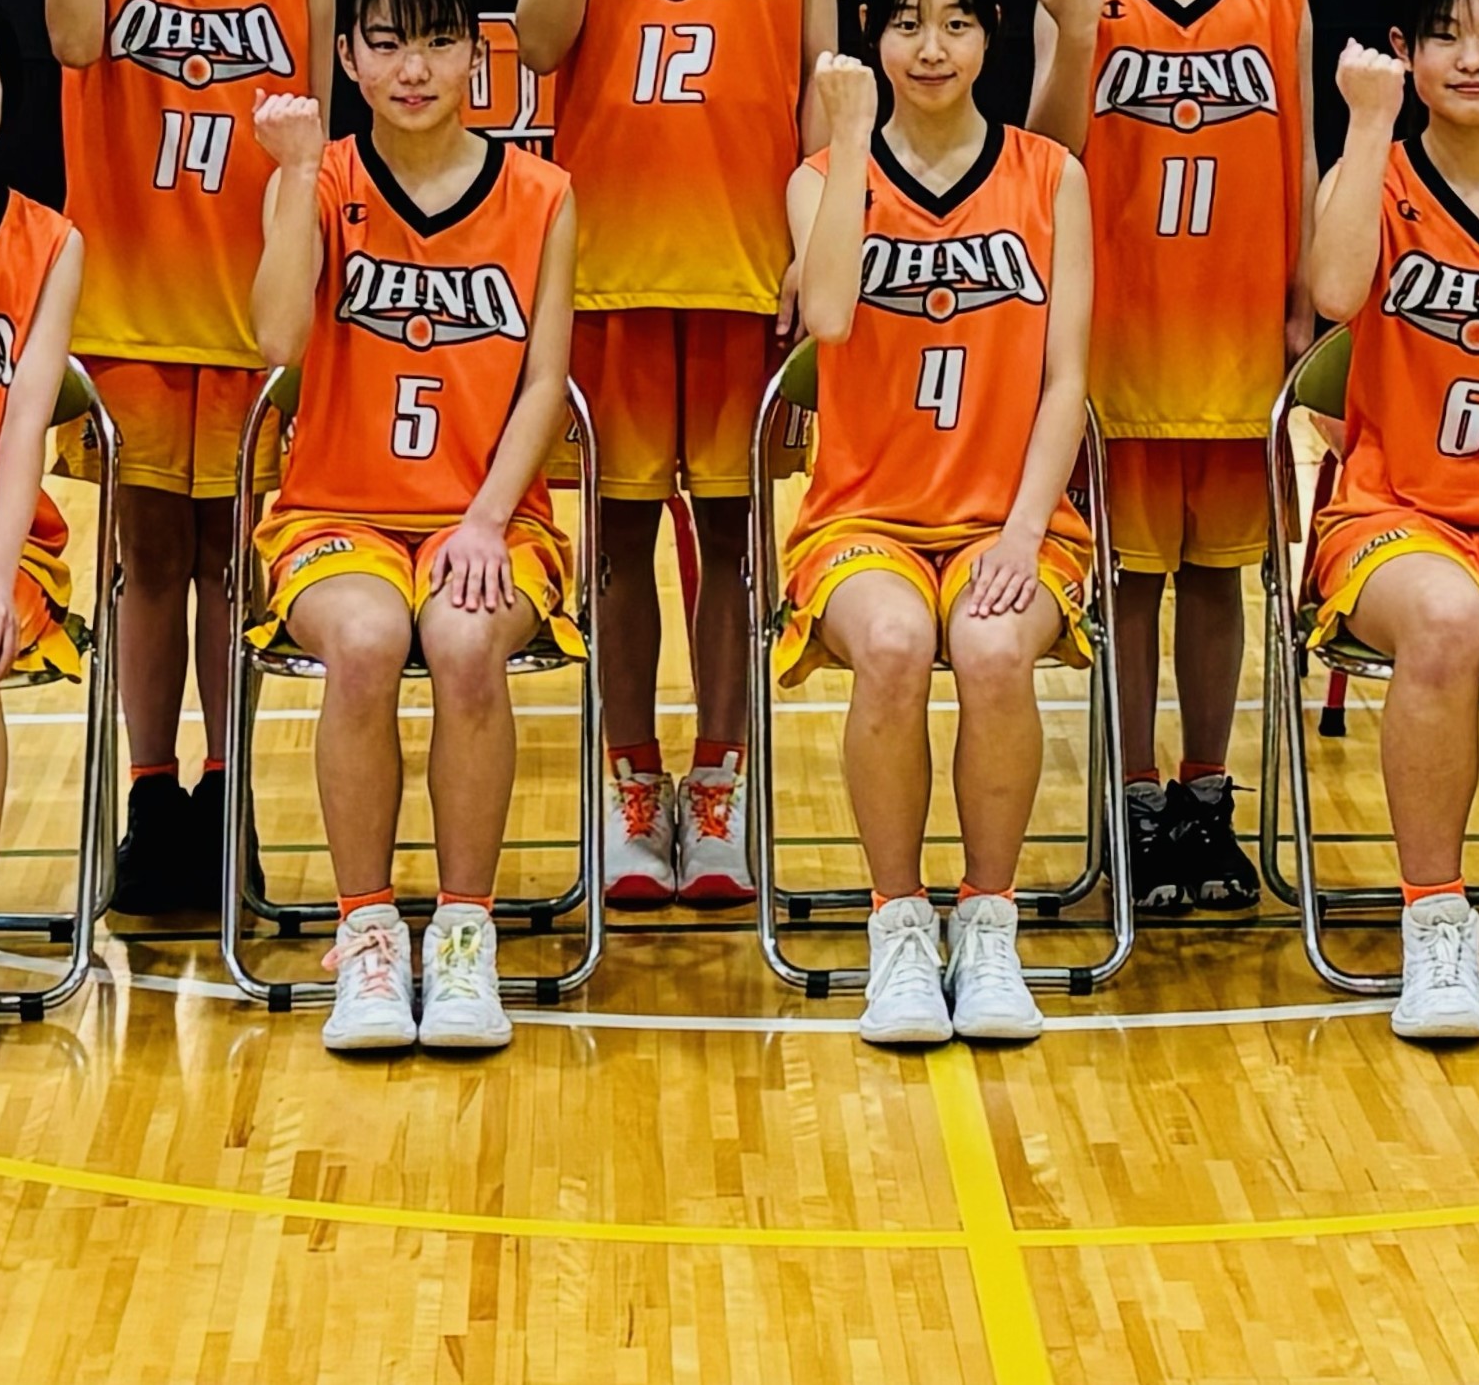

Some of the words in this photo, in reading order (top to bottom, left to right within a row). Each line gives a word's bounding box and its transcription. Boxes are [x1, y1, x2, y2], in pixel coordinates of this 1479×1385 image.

[633, 24, 715, 104] 12
[1094, 44, 1279, 117] OHNO
[152, 110, 235, 194] 14
[1156, 156, 1215, 238] 11
[334, 250, 528, 342] OHNO
[861, 228, 1047, 306] OHNO
[389, 375, 442, 459] 5
[915, 346, 966, 430] 4
